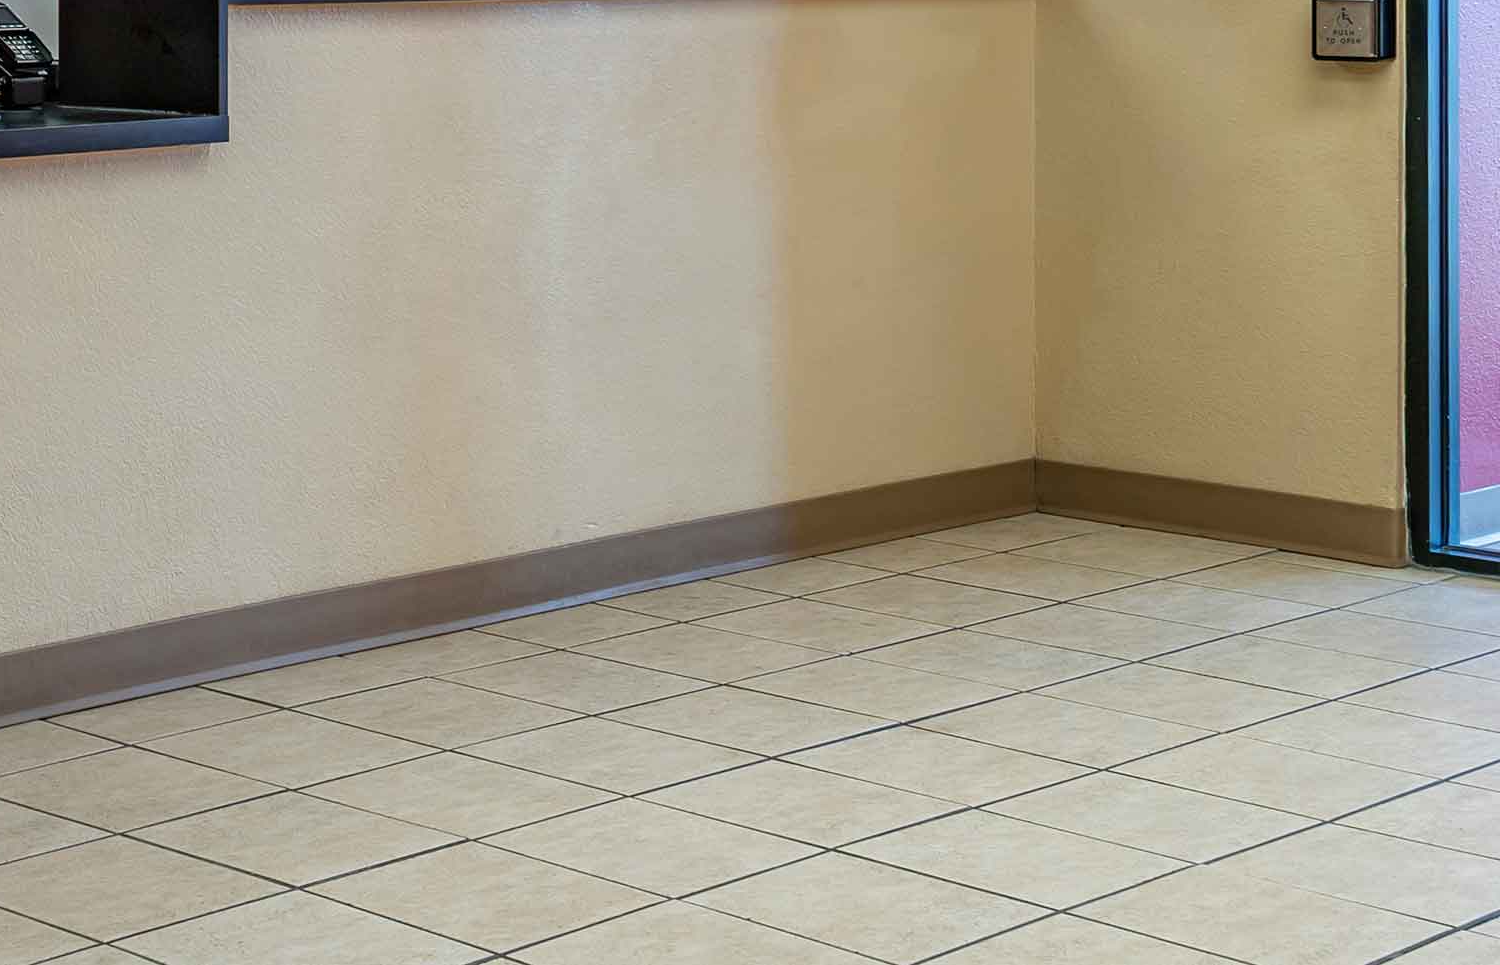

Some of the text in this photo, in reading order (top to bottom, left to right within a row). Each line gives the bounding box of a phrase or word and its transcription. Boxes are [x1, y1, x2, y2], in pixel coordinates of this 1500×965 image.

[1332, 29, 1355, 37] PUSH
[1325, 37, 1362, 45] TO OPEN
